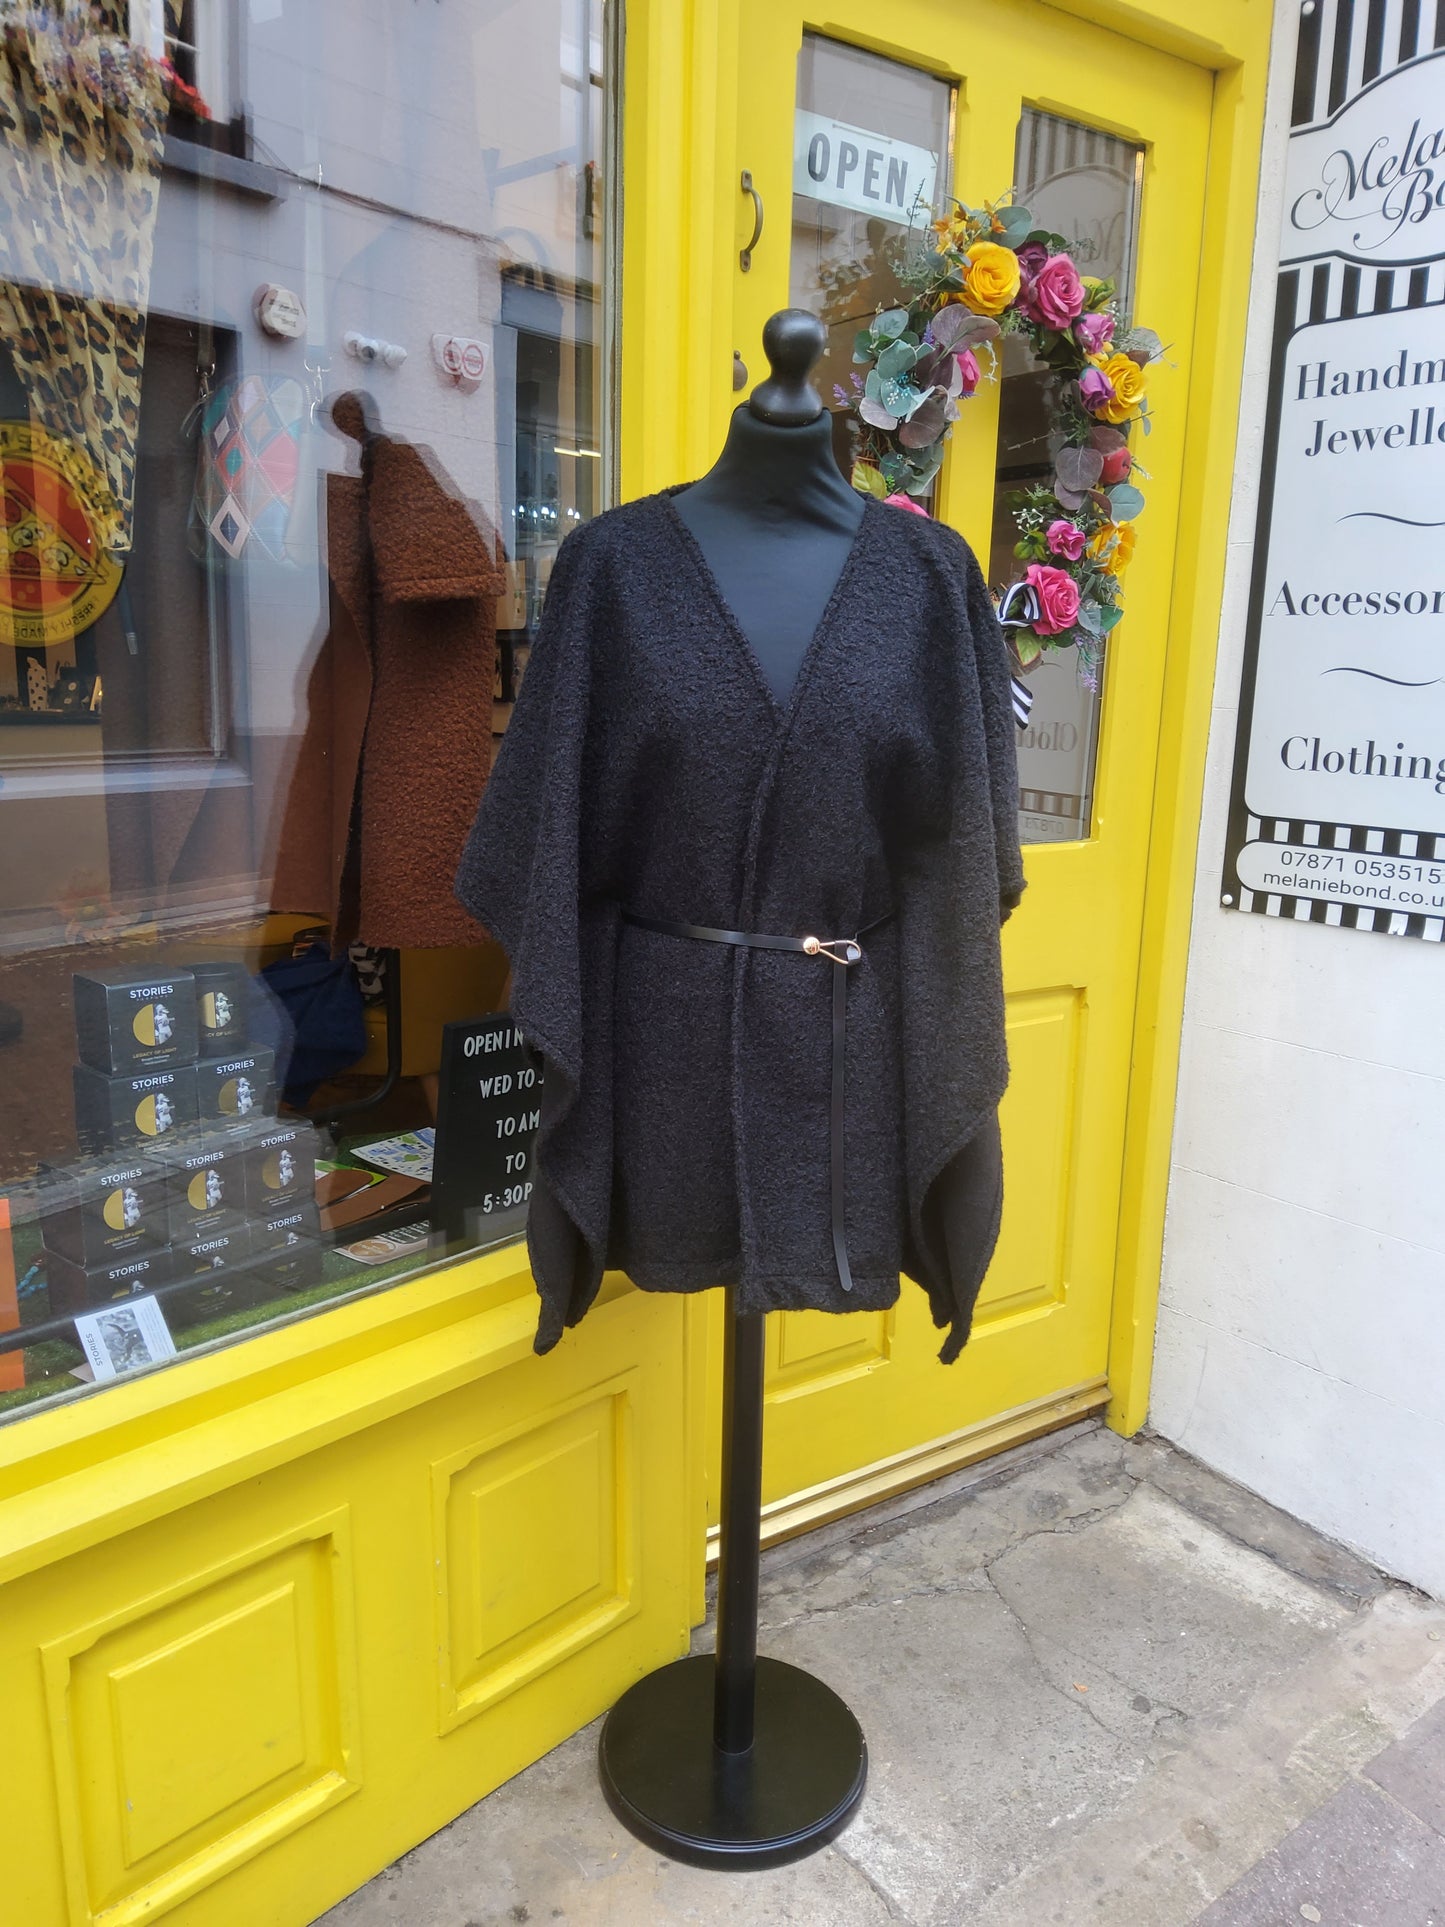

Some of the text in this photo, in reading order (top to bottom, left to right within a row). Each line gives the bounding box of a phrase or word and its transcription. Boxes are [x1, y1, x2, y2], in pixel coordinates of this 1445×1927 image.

[808, 132, 908, 207] OPEN
[1281, 851, 1344, 872] 07871
[129, 985, 173, 999] STORIES
[216, 1059, 255, 1074] STORIES
[132, 1074, 174, 1090] STORIES
[480, 1069, 535, 1099] WED TO
[496, 1110, 540, 1139] 10 AM
[261, 1132, 296, 1148] STORIES
[186, 1151, 224, 1168] STORIES
[505, 1152, 526, 1174] TO
[101, 1168, 142, 1186] STORIES
[267, 1214, 303, 1231] STORIES
[191, 1237, 229, 1255] STORIES
[109, 1261, 150, 1279] STORIES
[86, 1333, 103, 1366] STORIES
